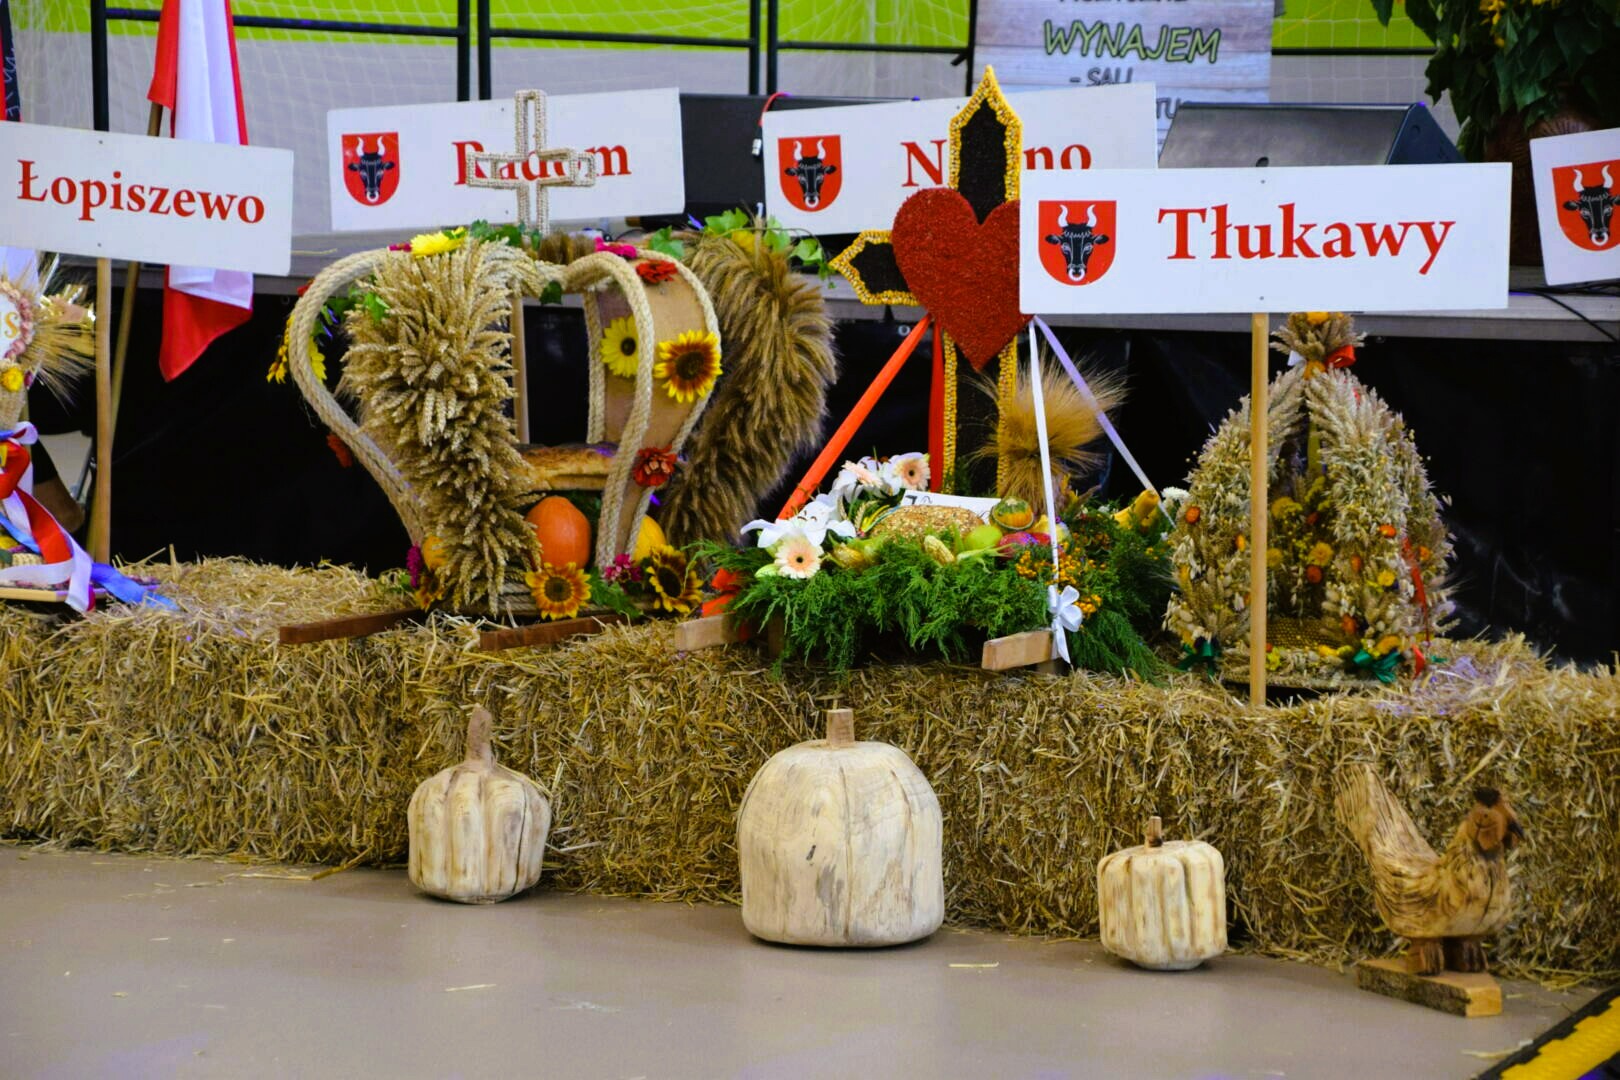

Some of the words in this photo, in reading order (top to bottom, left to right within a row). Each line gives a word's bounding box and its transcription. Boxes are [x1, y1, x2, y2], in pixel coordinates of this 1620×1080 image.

[1044, 19, 1222, 64] WYNAJEM
[17, 159, 265, 224] Łopiszewo
[1157, 202, 1456, 275] Tłukawy
